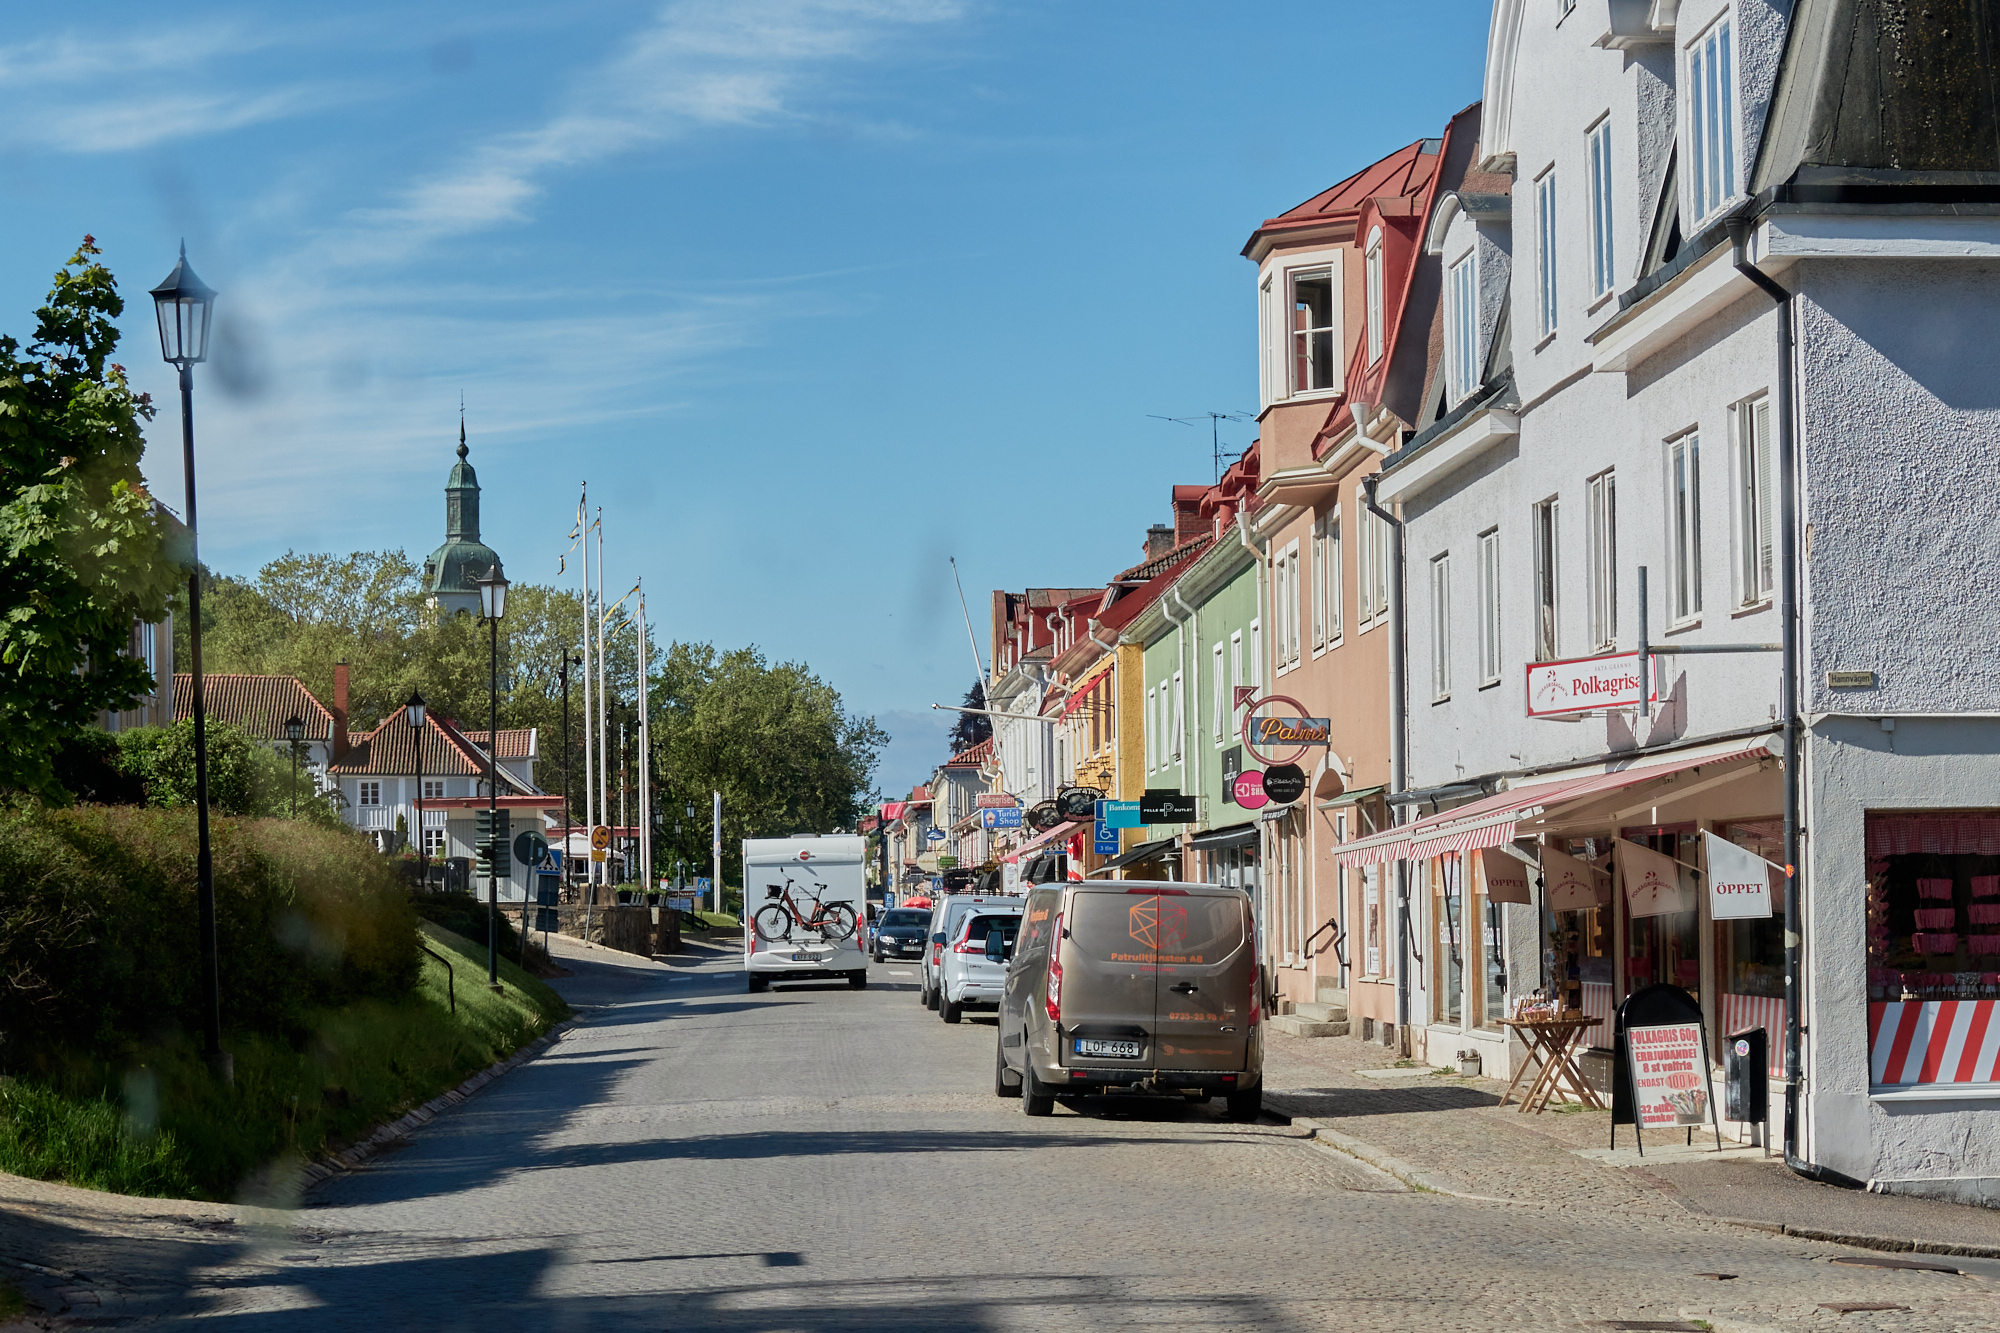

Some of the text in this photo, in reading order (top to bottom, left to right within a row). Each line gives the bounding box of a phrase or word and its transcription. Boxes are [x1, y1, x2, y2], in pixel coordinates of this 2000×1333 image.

[1609, 662, 1632, 671] GRÄNNA
[1831, 674, 1870, 685] Hamnvägen
[1259, 716, 1327, 743] Palms
[1250, 787, 1265, 796] SHO
[978, 794, 1015, 807] Polkagrisen
[997, 809, 1020, 818] Turist
[999, 817, 1020, 826] Shop
[1490, 876, 1524, 888] ÖPPET
[1716, 882, 1763, 895] ÖPPET
[1189, 955, 1204, 964] AB
[1629, 1027, 1698, 1045] POLKAGRIS 60g
[1085, 1040, 1134, 1054] LOF 668
[1642, 1061, 1693, 1073] 8 st valfria
[1637, 1074, 1698, 1089] ENDAST 100 kr
[1640, 1104, 1653, 1114] 32
[1642, 1113, 1676, 1124] smaker
